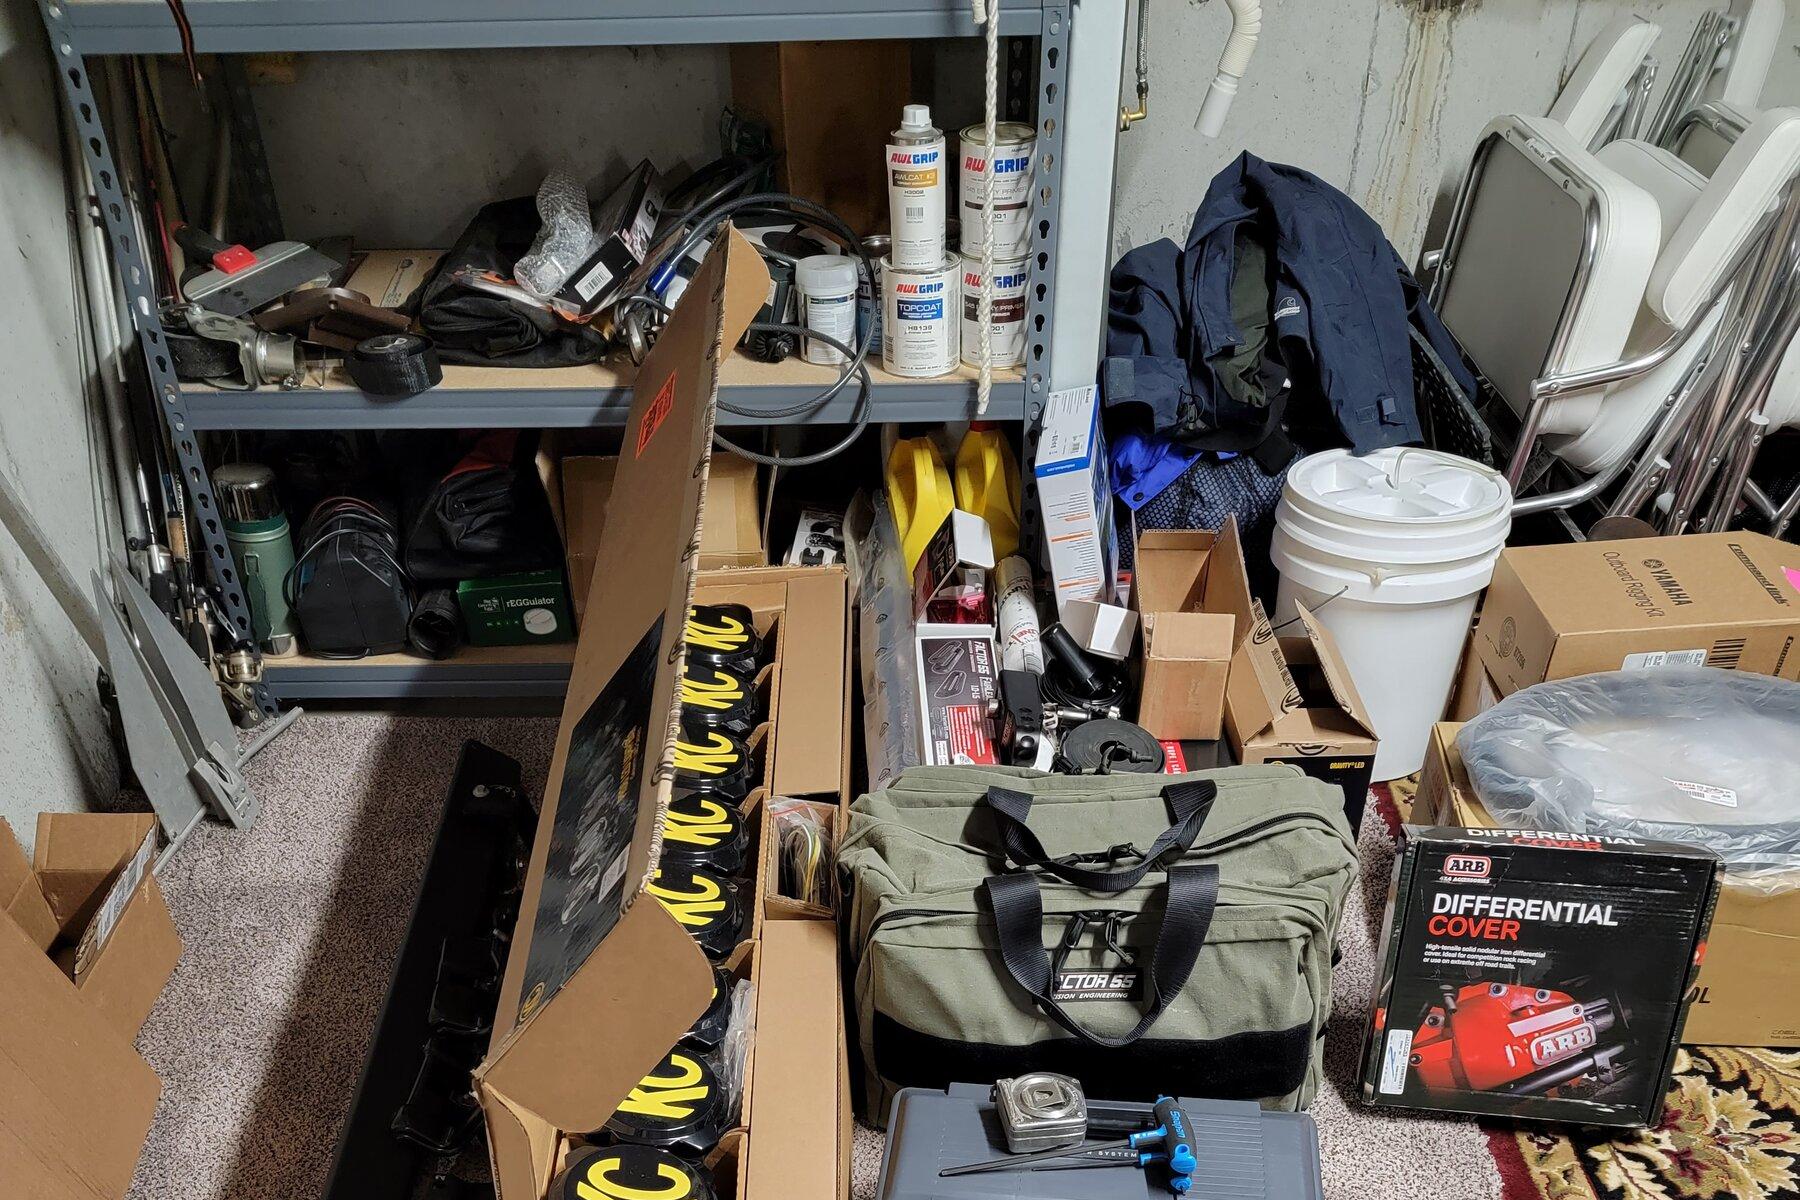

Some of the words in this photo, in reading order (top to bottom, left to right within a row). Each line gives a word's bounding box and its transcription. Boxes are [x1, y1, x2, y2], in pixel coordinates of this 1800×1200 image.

[890, 151, 939, 165] AWLGRIP
[964, 156, 1029, 173] AWGRIP
[894, 173, 923, 181] AWLCAT
[896, 282, 944, 294] AWLGRIP
[964, 272, 1027, 289] AWGRIP
[899, 302, 942, 312] TOPCOAT
[1602, 551, 1635, 582] Outboard
[1626, 580, 1655, 608] Rigging
[1644, 606, 1666, 618] Kit
[1651, 568, 1693, 606] YAMAHA
[506, 597, 555, 608] rEGGulator
[685, 609, 749, 651] KC
[680, 665, 744, 709] KC
[673, 727, 739, 774] KC
[663, 795, 733, 846] KC
[1467, 828, 1646, 847] DIFFERENTIAL
[1513, 838, 1604, 851] COVER
[1449, 859, 1486, 873] ARB
[1432, 892, 1619, 927] DIFFERENTIAL
[1428, 914, 1521, 941] COVER
[1425, 943, 1461, 952] High-tensile
[1461, 944, 1477, 952] solid
[1477, 946, 1500, 954] nodular
[1500, 947, 1513, 955] iron
[1513, 949, 1546, 958] differential
[1442, 950, 1457, 958] Ideal
[1467, 953, 1503, 963] competition
[1503, 955, 1517, 963] rock
[1517, 957, 1537, 966] racing
[1484, 960, 1498, 968] road
[1060, 974, 1109, 989] CTOR
[1109, 974, 1137, 989] 55
[1541, 1027, 1592, 1060] ARB
[616, 1054, 709, 1119] KC
